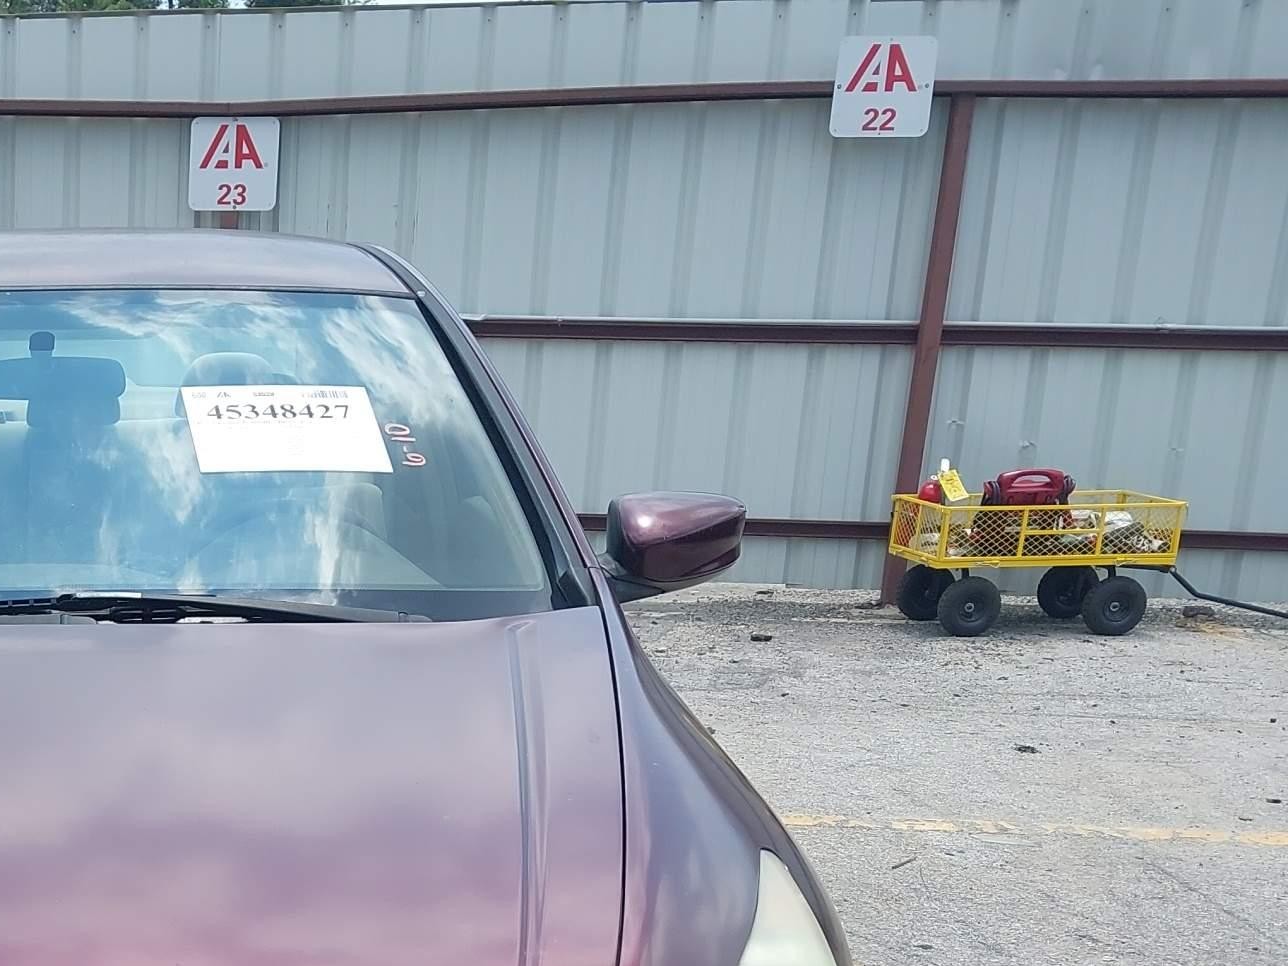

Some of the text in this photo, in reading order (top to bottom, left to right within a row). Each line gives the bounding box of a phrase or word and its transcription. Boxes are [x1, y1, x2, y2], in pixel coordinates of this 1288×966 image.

[861, 107, 897, 131] 22
[216, 183, 248, 206] 23
[206, 403, 350, 420] 45348427
